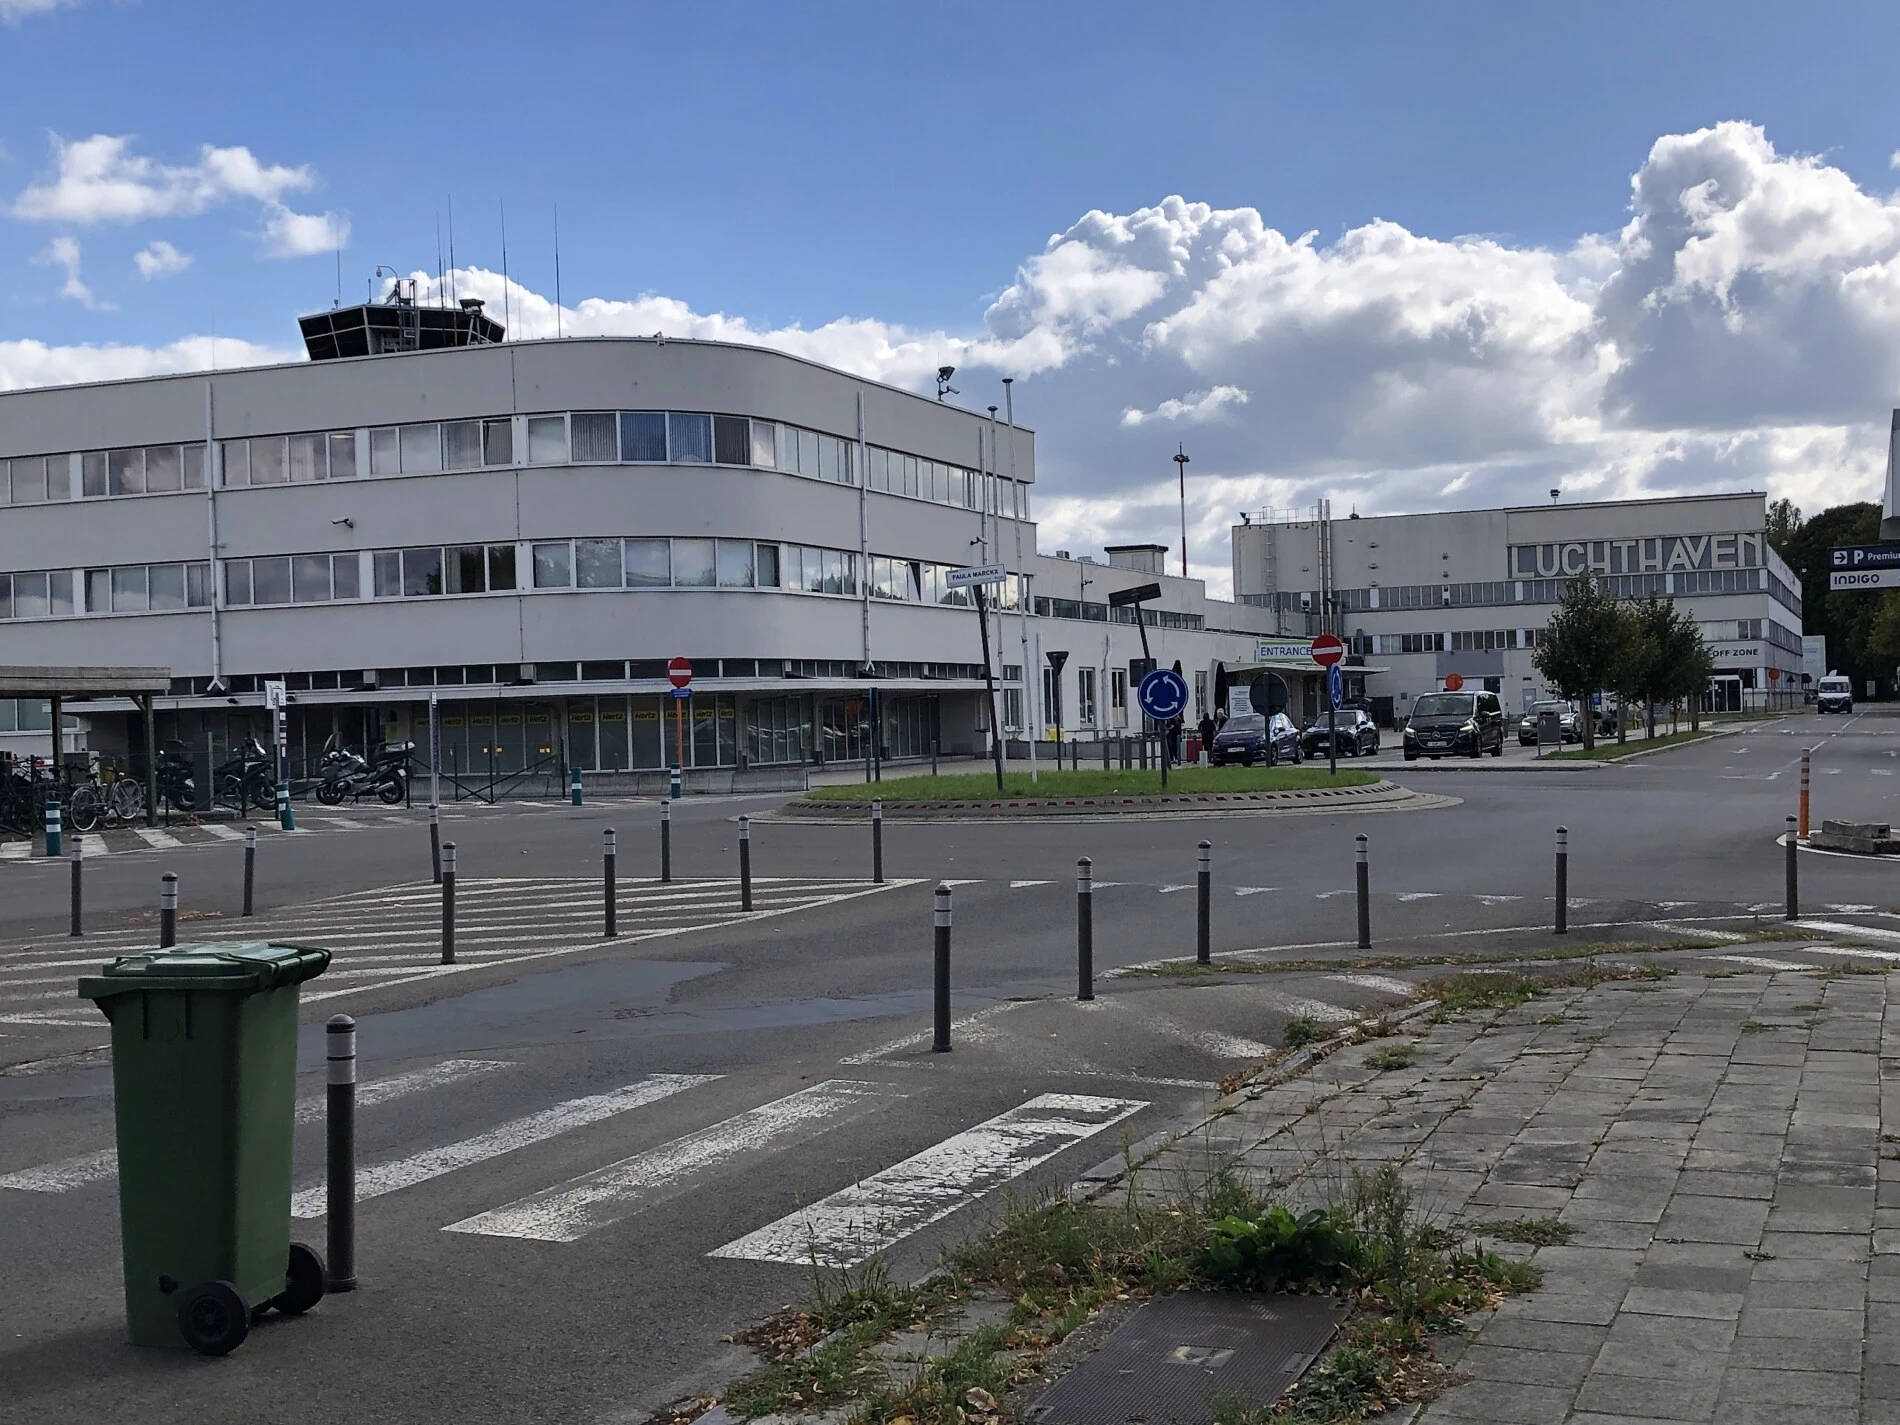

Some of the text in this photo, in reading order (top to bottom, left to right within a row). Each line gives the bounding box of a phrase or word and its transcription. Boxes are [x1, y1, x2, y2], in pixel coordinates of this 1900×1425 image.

[1511, 533, 1763, 578] LUCHTHAVEN
[1853, 550, 1864, 564] P
[972, 569, 999, 577] MARCKX
[1834, 574, 1880, 584] INDIGO
[1261, 646, 1312, 656] ENTRANCE
[1733, 648, 1758, 656] ZONE
